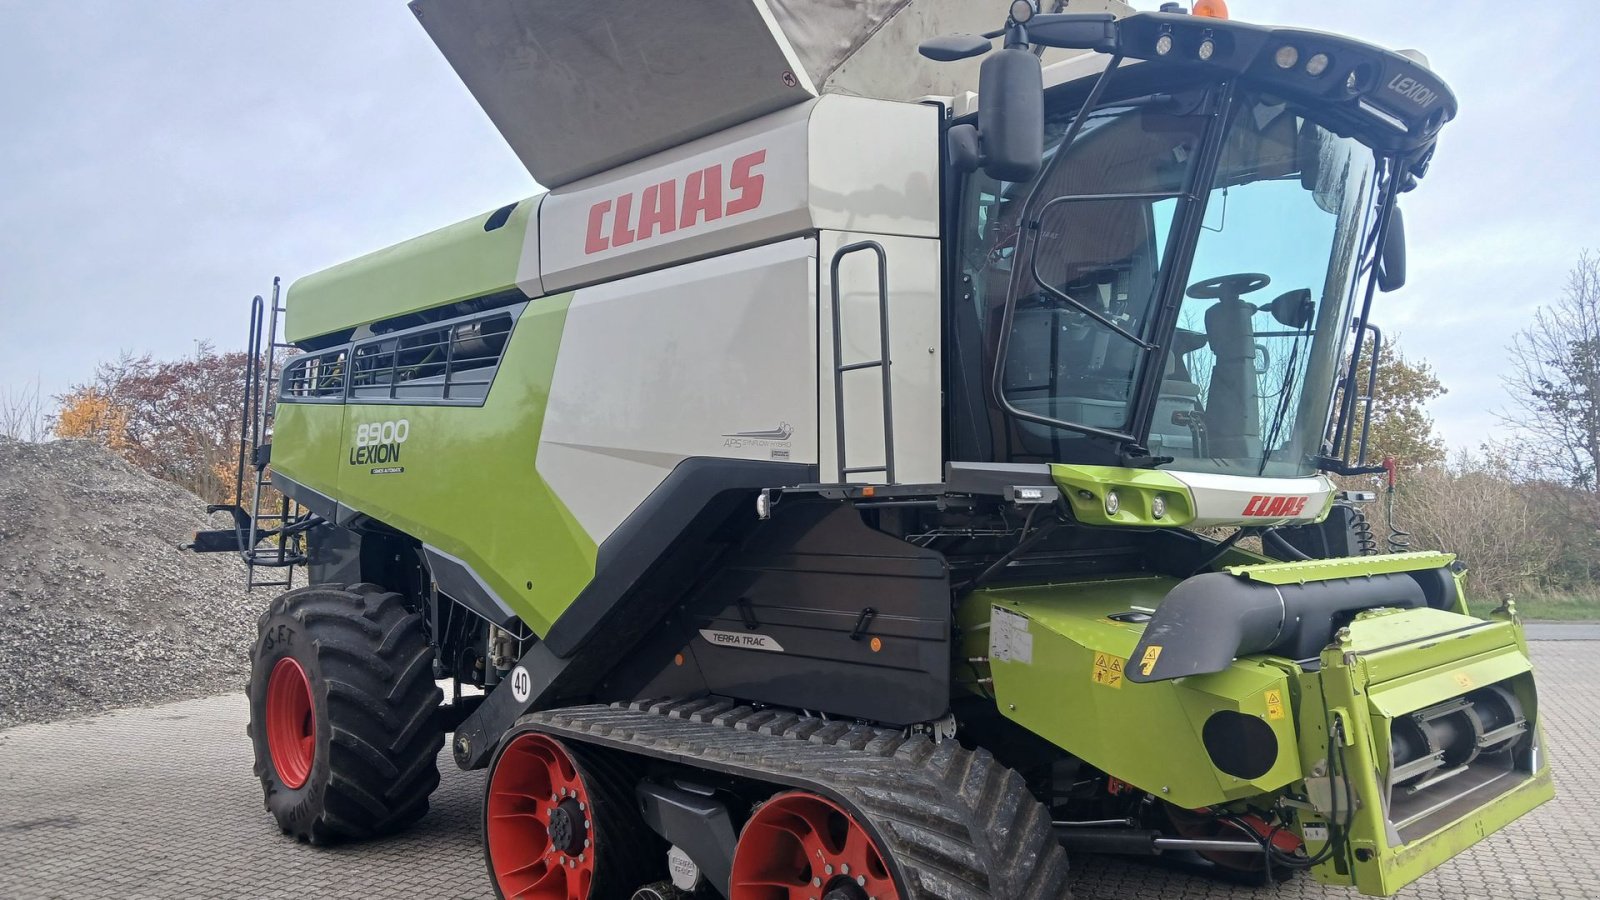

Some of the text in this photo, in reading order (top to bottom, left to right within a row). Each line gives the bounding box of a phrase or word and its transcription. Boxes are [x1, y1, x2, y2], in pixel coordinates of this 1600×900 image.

[1387, 73, 1438, 108] LEXION
[585, 149, 767, 254] CLAAS
[357, 419, 409, 446] 8900
[350, 443, 400, 465] LEXION
[1242, 496, 1308, 516] CLAAS
[713, 633, 765, 646] TERRA TRAC
[515, 672, 527, 695] 40
